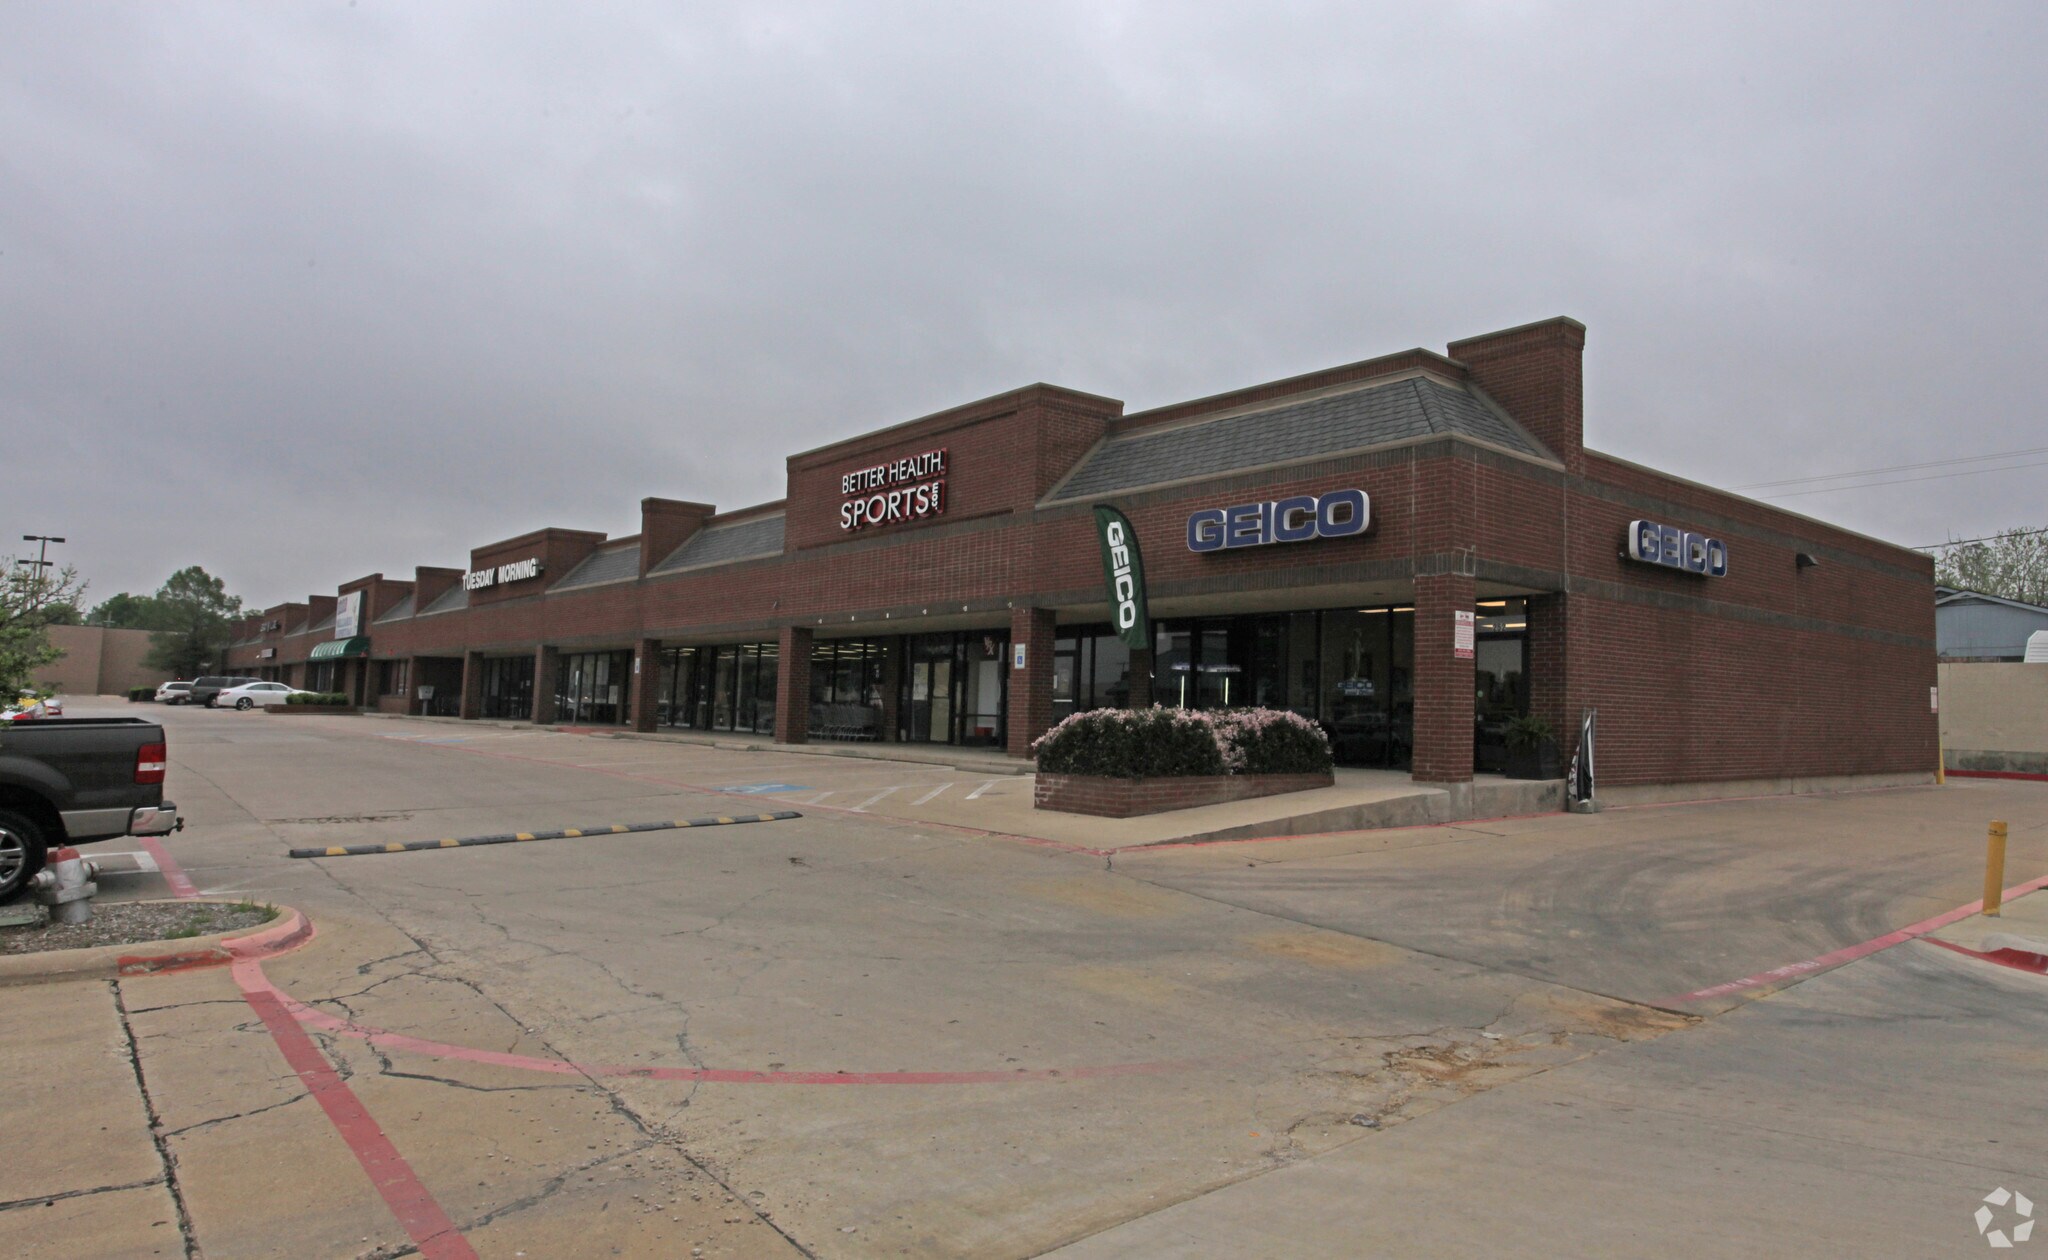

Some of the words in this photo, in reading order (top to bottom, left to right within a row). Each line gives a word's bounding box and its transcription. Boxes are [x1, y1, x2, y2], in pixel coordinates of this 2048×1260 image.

[842, 465, 885, 494] BETTER
[889, 450, 941, 483] HEALTH
[840, 485, 929, 529] SPORTS
[1187, 489, 1367, 552] GEICO
[1631, 520, 1728, 577] GEICO
[462, 567, 495, 591] TUESDAY
[498, 558, 537, 584] MORNING
[1107, 521, 1136, 629] GEICO
